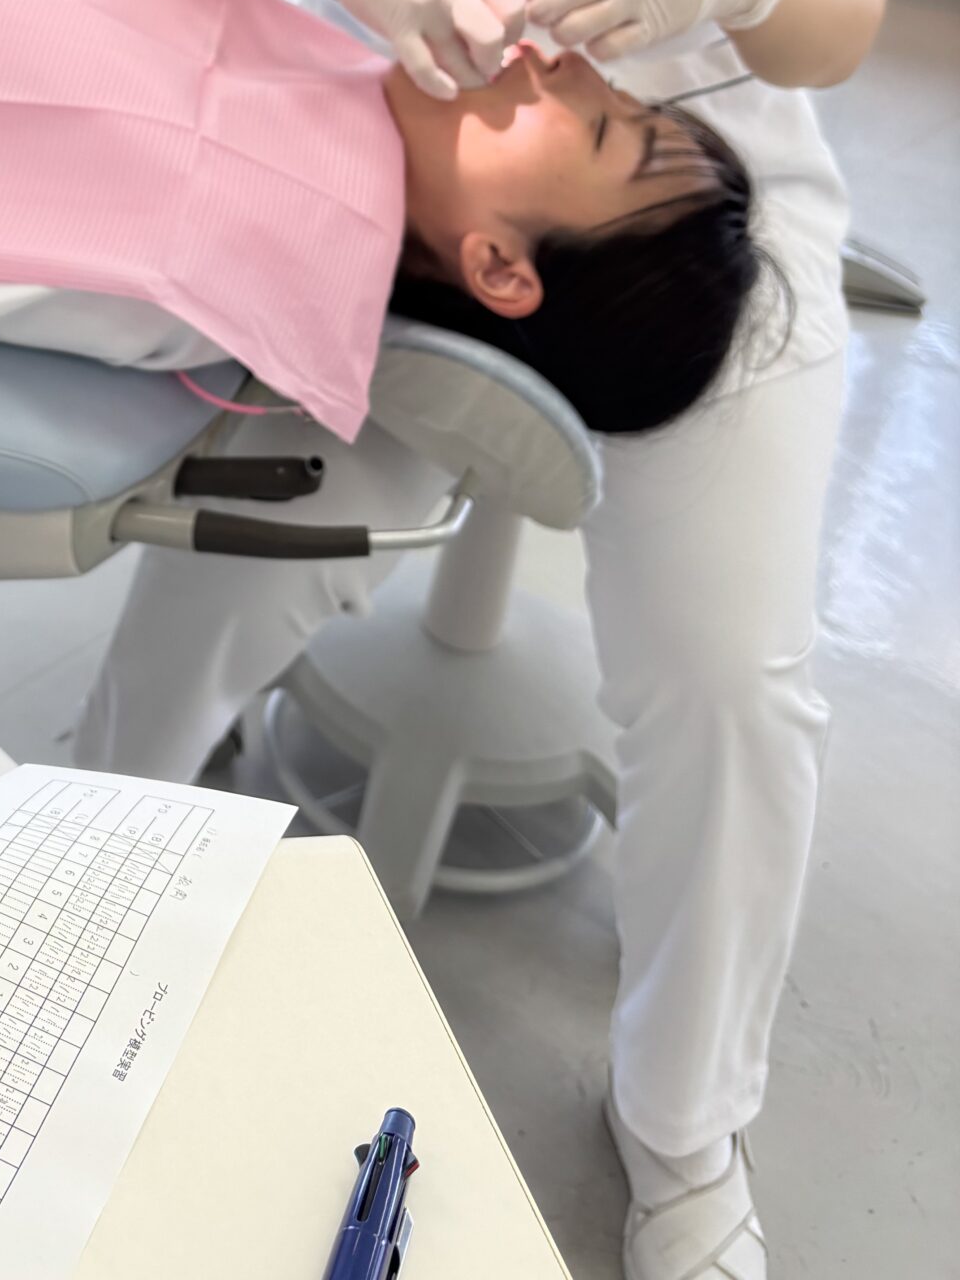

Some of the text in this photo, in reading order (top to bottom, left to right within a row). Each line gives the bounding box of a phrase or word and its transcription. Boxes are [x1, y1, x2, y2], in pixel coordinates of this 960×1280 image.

[23, 937, 34, 945] 3
[7, 962, 19, 971] 2
[113, 983, 168, 1081] プロービング模型実習
